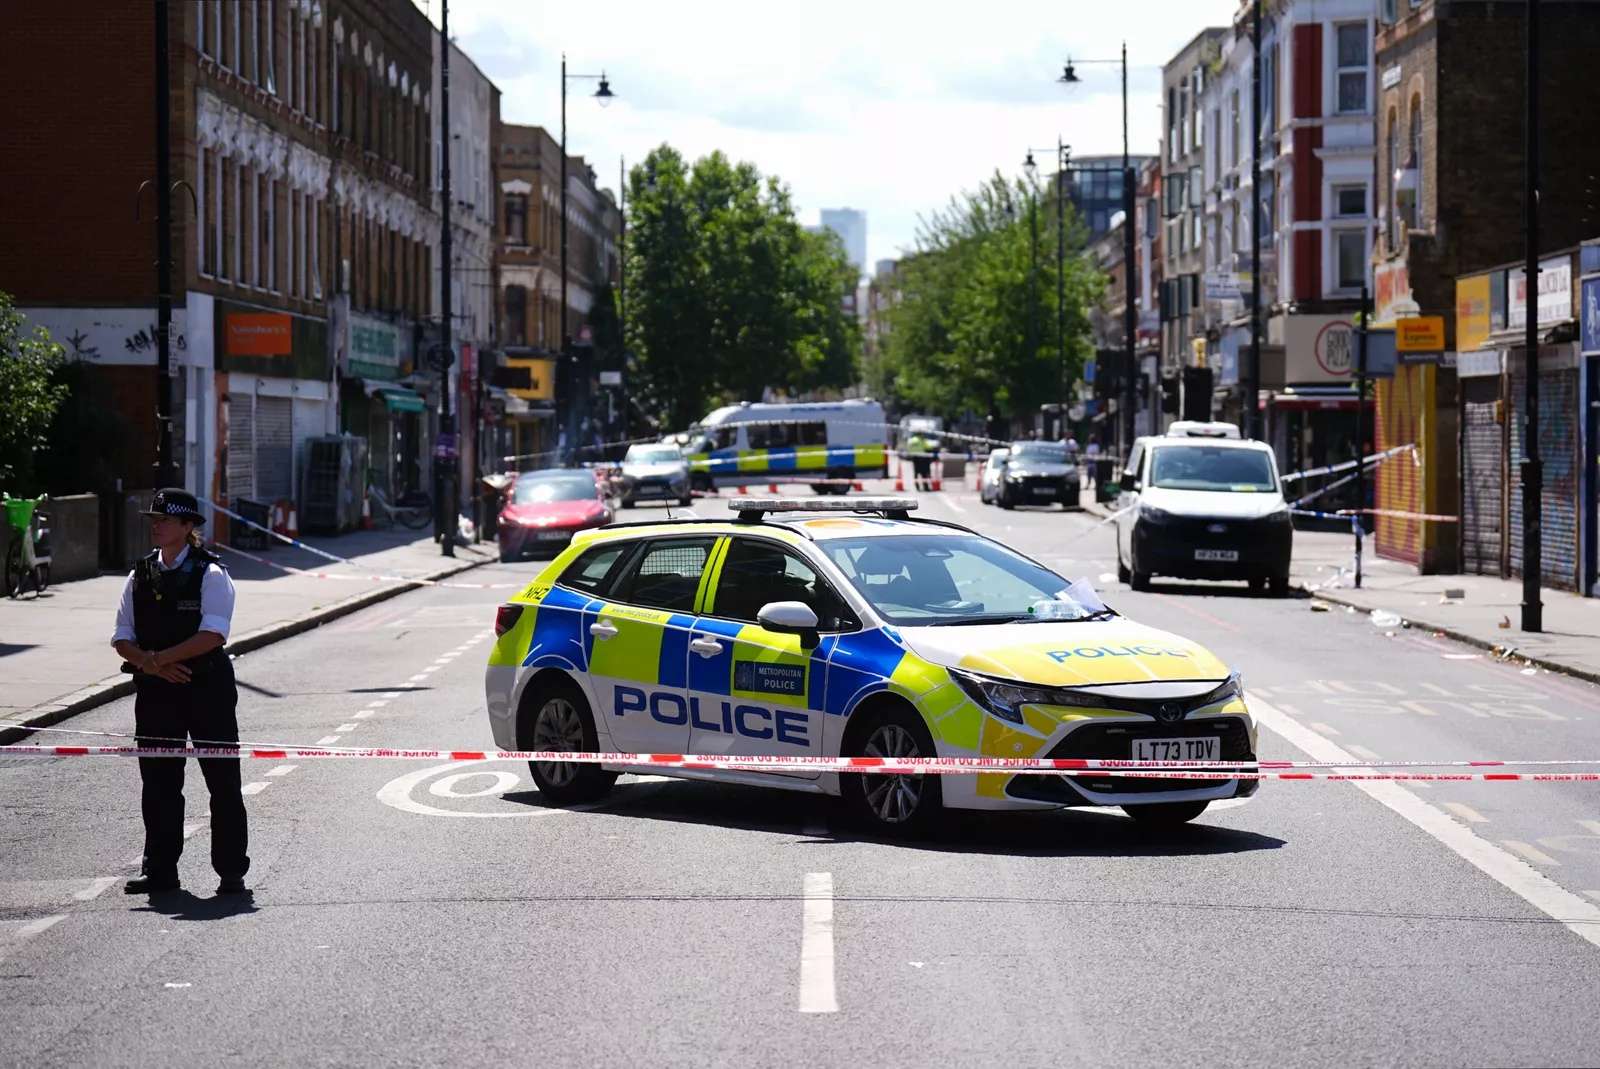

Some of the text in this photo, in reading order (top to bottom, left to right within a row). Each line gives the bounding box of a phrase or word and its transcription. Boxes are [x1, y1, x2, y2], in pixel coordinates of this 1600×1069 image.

[522, 587, 550, 600] NHZ
[611, 606, 660, 620] www.met.police.uk
[1046, 645, 1188, 663] POLICE
[758, 667, 802, 678] METROPOLITAN
[764, 679, 795, 690] POLICE
[614, 685, 810, 747] POLICE
[1138, 740, 1213, 761] LT73 TDV
